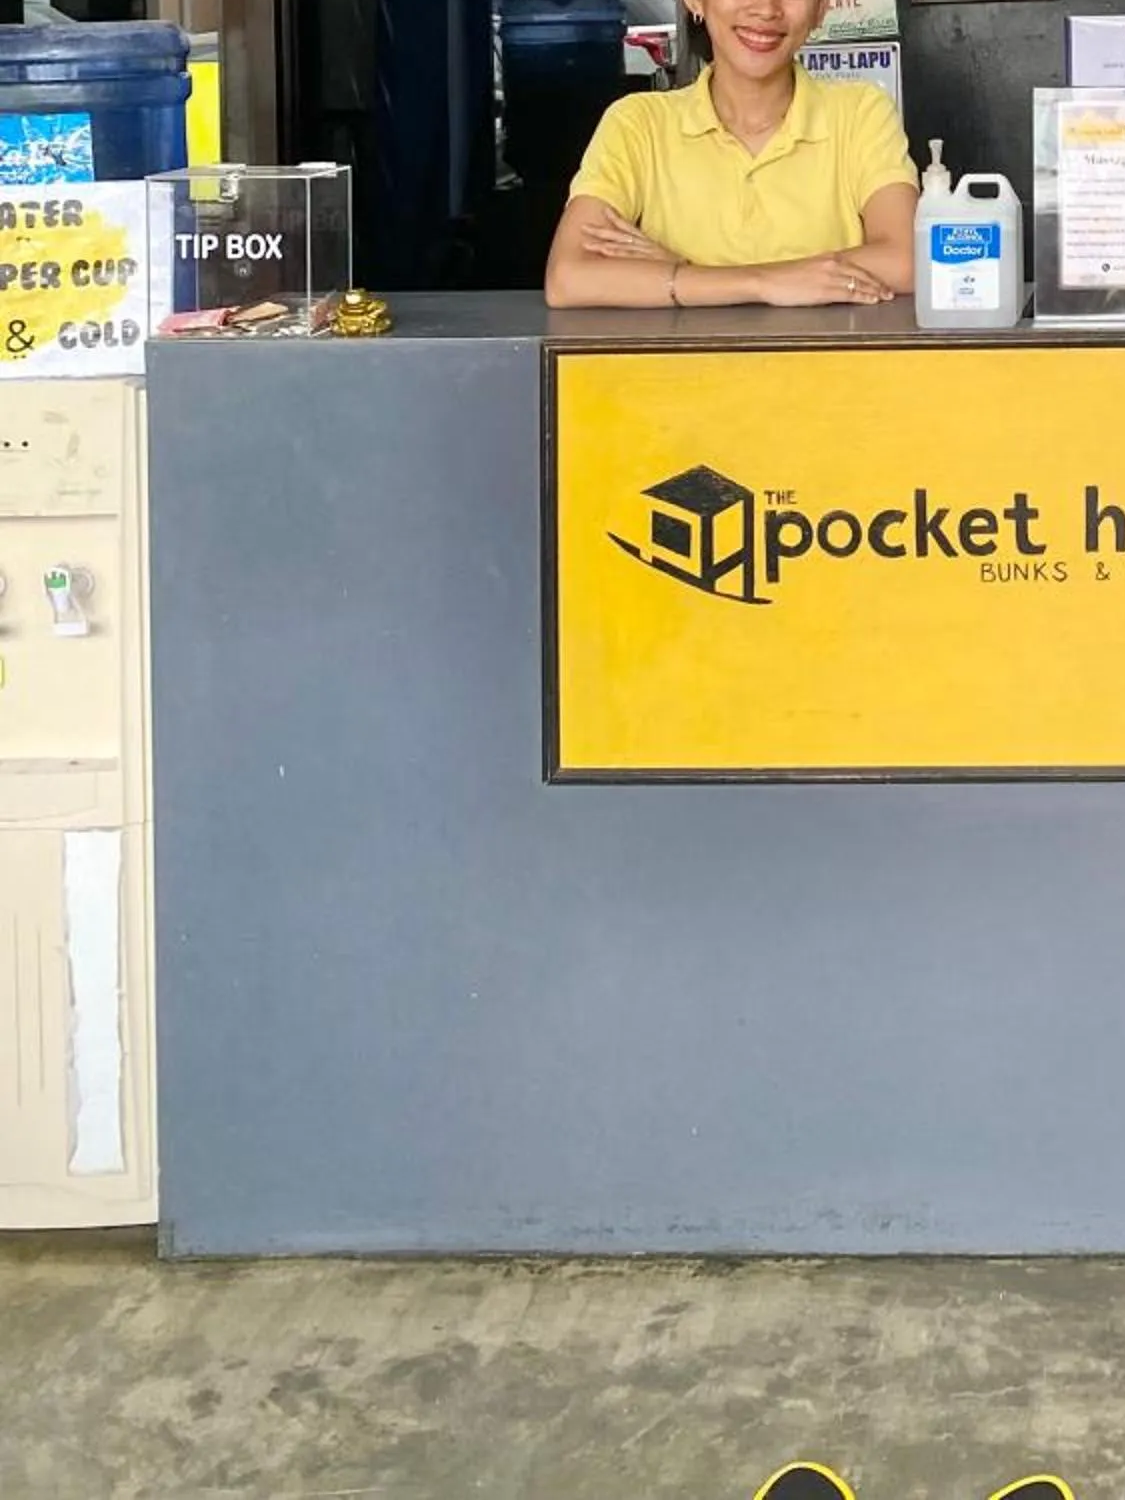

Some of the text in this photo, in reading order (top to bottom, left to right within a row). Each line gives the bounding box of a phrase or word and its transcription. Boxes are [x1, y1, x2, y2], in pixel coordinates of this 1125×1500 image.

[175, 234, 283, 259] TIP BOX
[943, 244, 983, 256] Doctor
[71, 257, 137, 287] CUP
[6, 319, 140, 352] & COLD
[764, 490, 796, 504] THE
[765, 489, 1046, 583] pocket
[980, 562, 1068, 583] BUNKS
[1095, 561, 1110, 581] &
